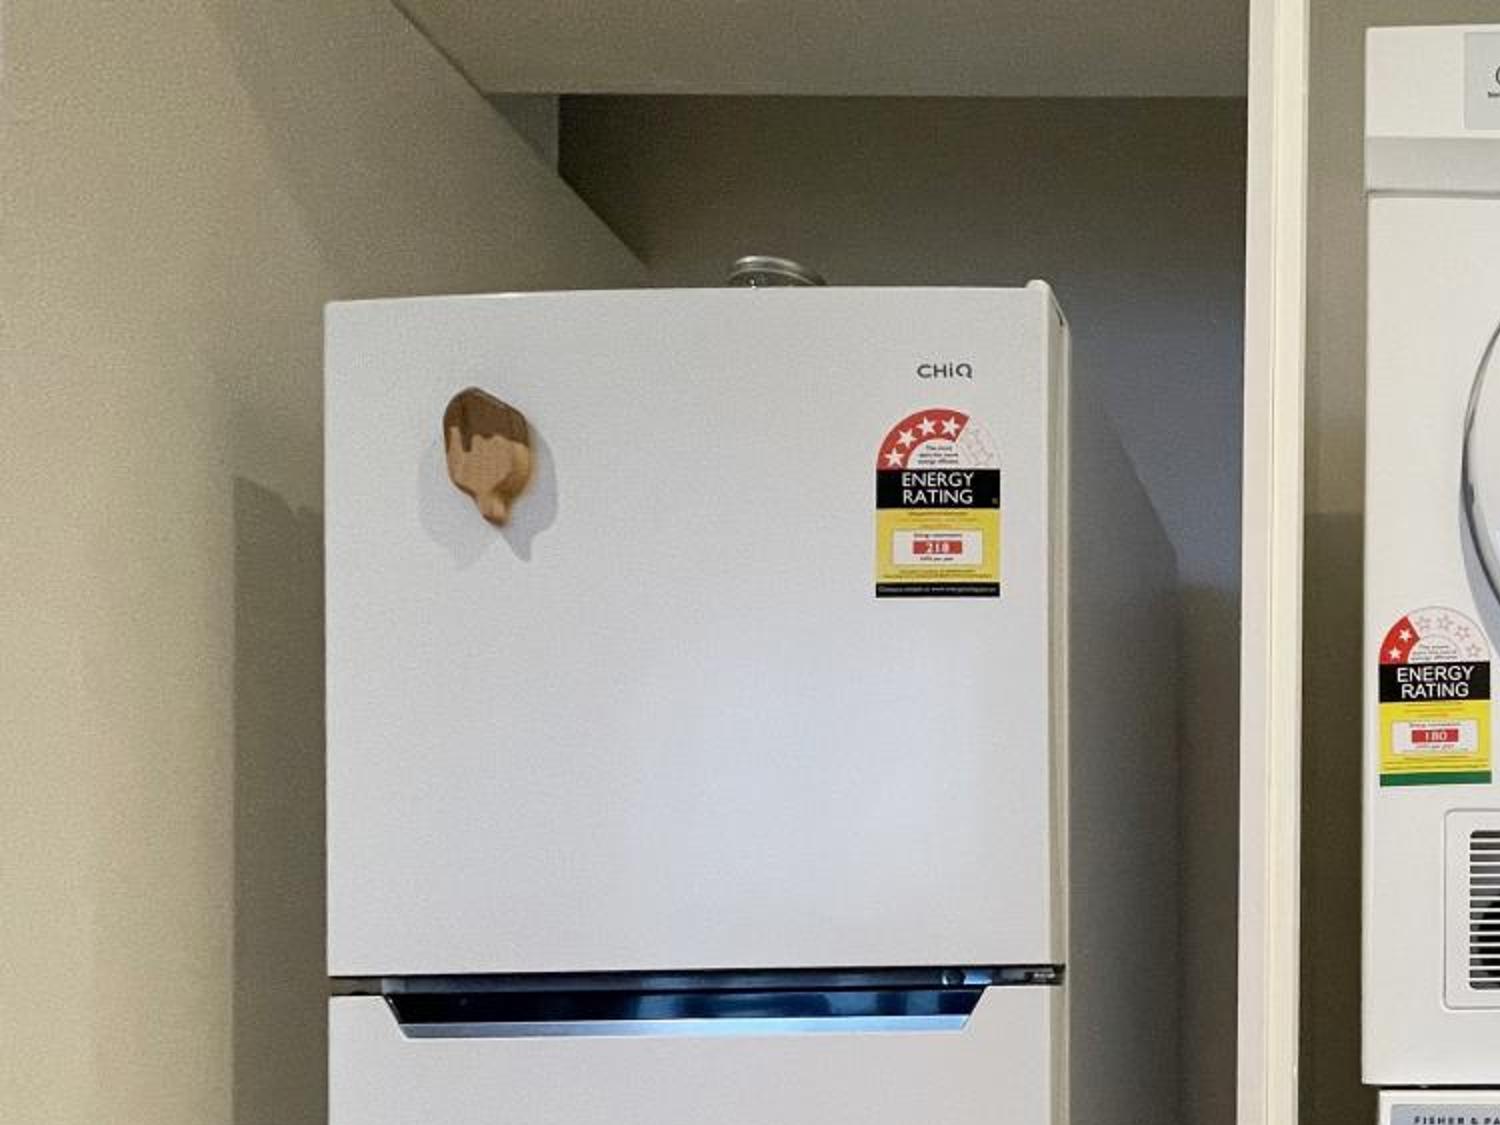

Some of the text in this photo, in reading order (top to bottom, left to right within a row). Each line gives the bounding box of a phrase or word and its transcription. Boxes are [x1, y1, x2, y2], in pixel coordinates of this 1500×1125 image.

[901, 471, 975, 487] ENERGY
[902, 489, 973, 504] RATING
[1396, 665, 1475, 683] ENERGY
[1401, 681, 1470, 699] RATING
[1413, 1116, 1465, 1125] FISHER
[1469, 1117, 1479, 1125] &
